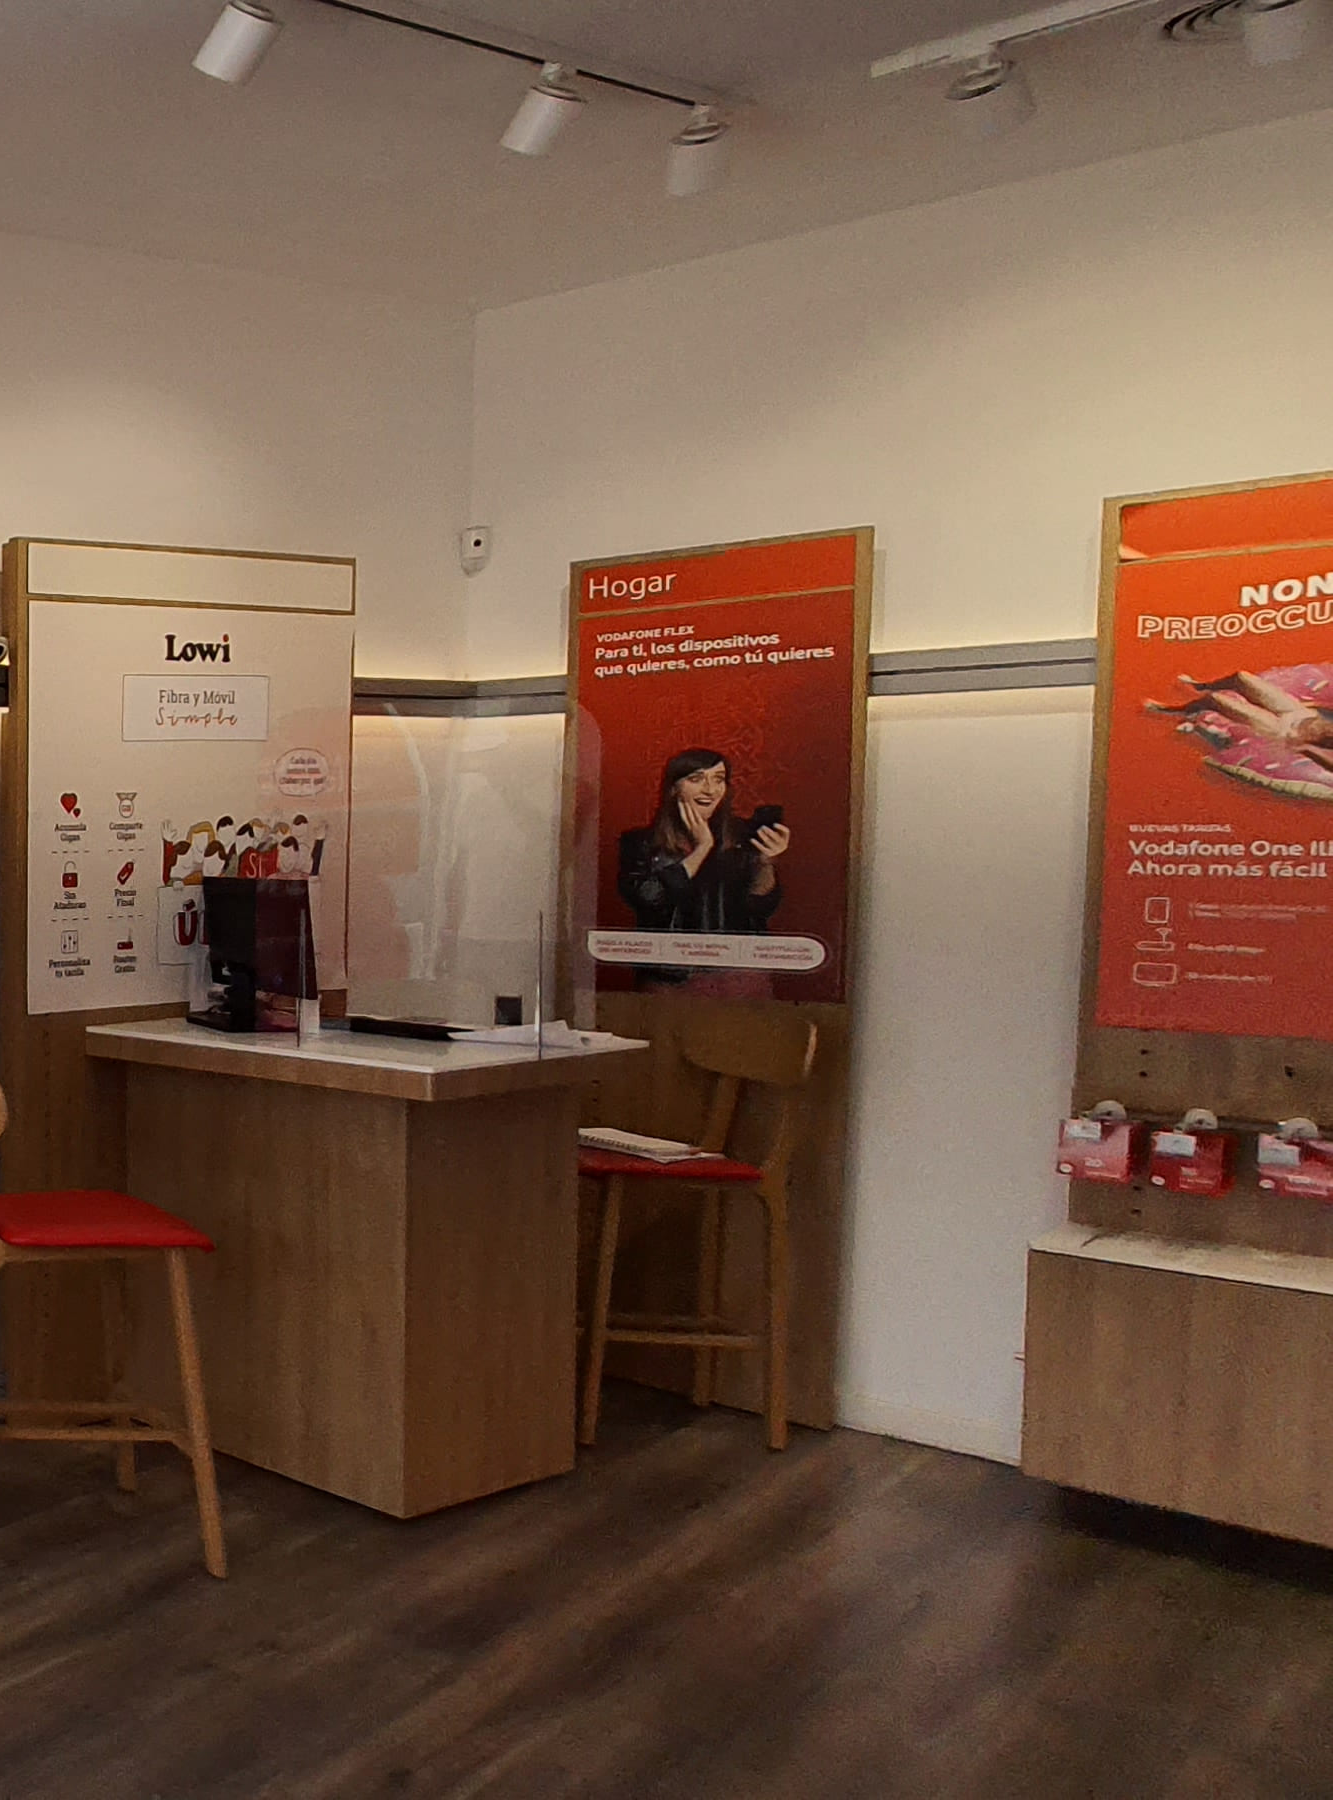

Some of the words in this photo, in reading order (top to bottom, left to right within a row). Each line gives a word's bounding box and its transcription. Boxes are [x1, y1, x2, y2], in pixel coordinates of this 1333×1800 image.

[588, 572, 677, 600] Hogar
[597, 629, 662, 643] VODAFONE
[664, 625, 694, 637] FLEX
[164, 633, 231, 663] Lowi
[595, 647, 629, 660] Para
[632, 644, 647, 658] ti,
[651, 642, 675, 655] los
[678, 633, 780, 653] dispositivos
[594, 664, 623, 678] que
[627, 658, 690, 677] quieres,
[693, 654, 740, 668] como
[744, 650, 763, 665] tú
[767, 646, 835, 665] quieres
[159, 690, 190, 704] Fibra
[193, 693, 200, 707] y
[203, 690, 236, 705] Móvil
[155, 707, 238, 728] Simple
[1128, 839, 1245, 857] Vodafone
[1250, 839, 1305, 857] One
[1127, 859, 1202, 876] Ahora
[1208, 860, 1263, 877] más
[1269, 860, 1328, 878] fácil
